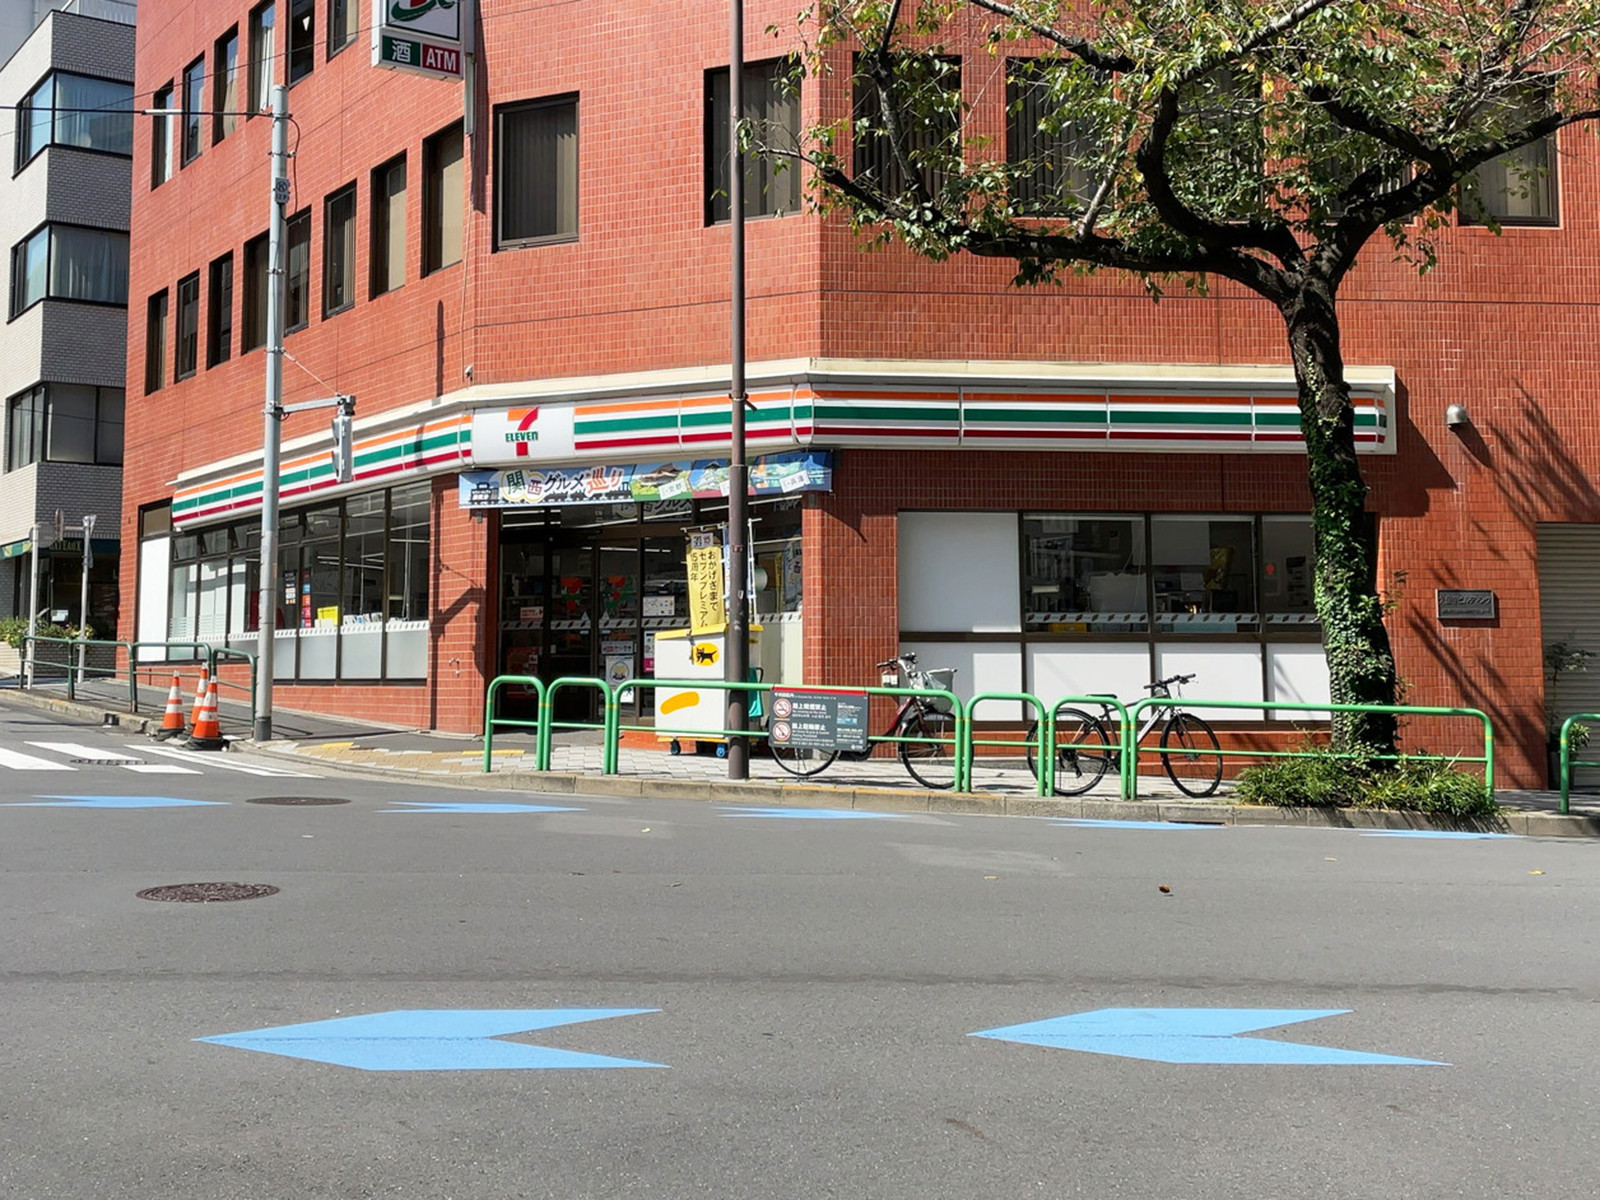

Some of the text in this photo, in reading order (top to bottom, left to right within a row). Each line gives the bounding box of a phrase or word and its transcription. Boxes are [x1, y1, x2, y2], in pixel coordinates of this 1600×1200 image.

[392, 40, 411, 62] 酒
[426, 47, 456, 71] ATM
[507, 467, 624, 494] 関西グルメ巡り
[708, 550, 718, 611] おかげさまで
